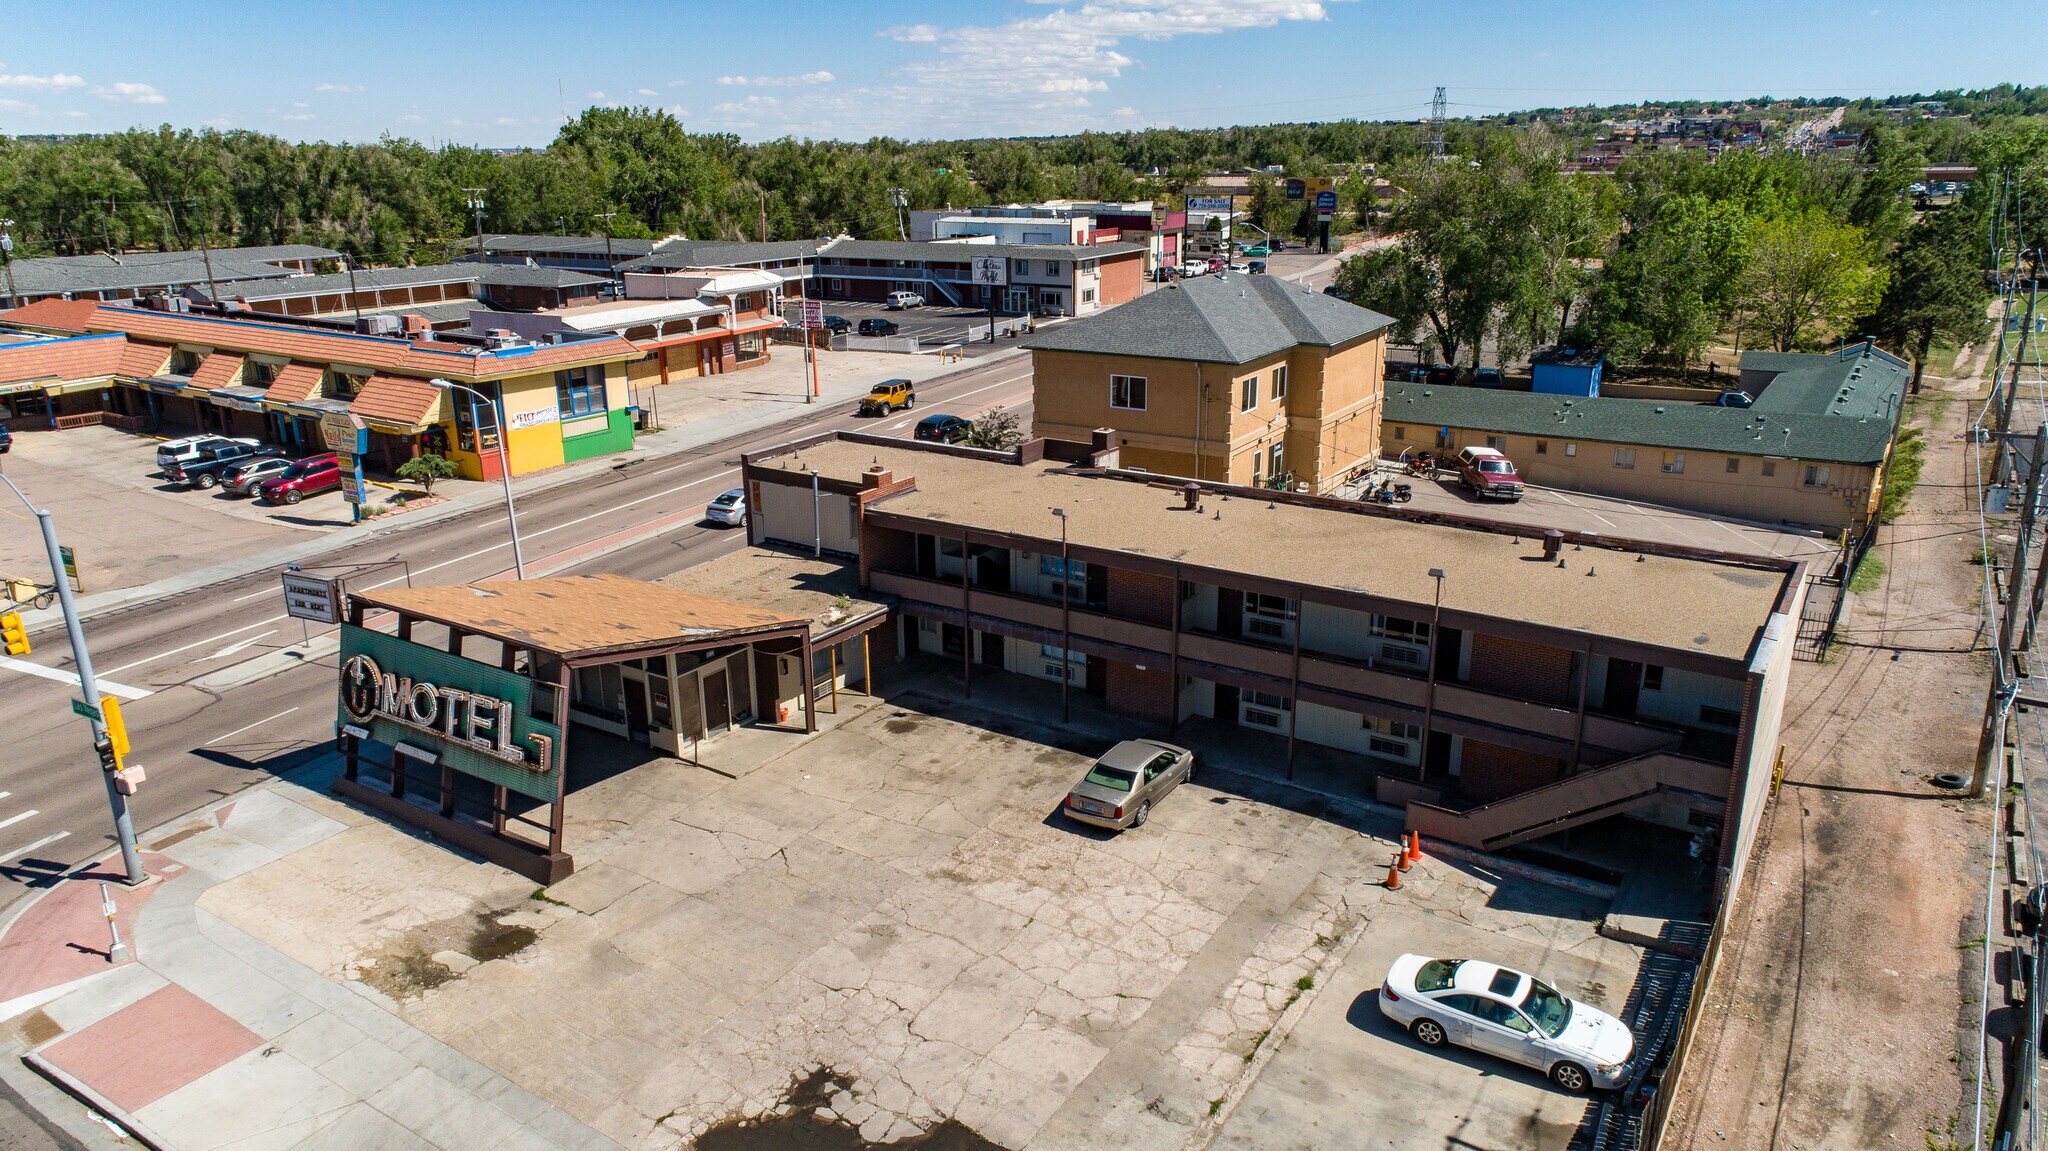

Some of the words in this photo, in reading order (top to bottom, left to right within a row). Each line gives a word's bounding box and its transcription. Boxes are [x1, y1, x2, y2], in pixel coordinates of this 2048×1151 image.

[324, 429, 340, 441] Nails
[289, 585, 328, 598] APARTMENTS
[294, 600, 306, 608] FOR
[74, 702, 83, 711] Las
[84, 704, 100, 718] Vegas
[382, 672, 525, 761] MOTEL
